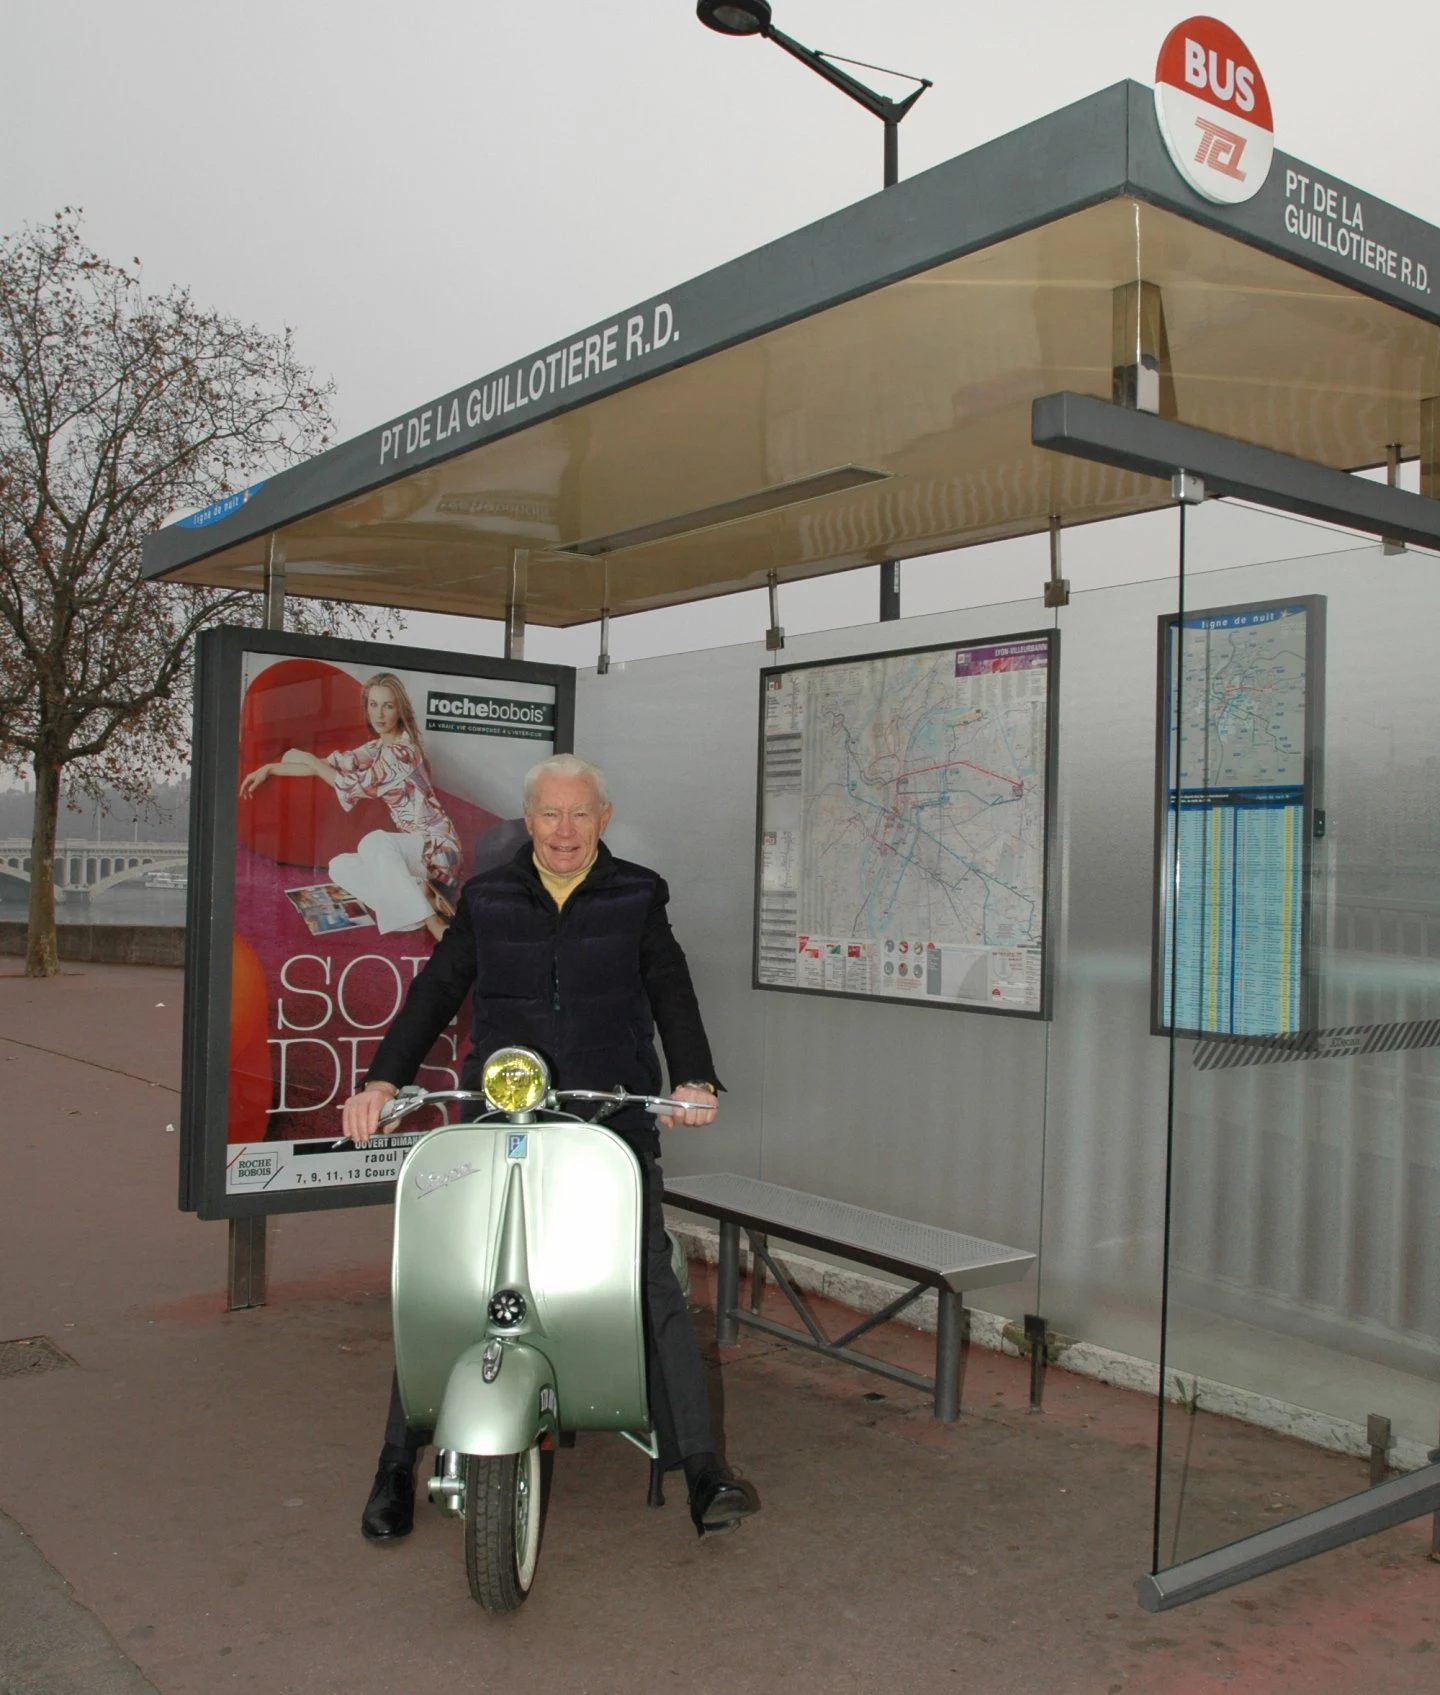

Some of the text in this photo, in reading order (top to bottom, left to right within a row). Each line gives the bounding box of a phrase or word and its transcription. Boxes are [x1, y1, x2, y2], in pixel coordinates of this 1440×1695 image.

[1184, 37, 1255, 112] BUS
[1286, 169, 1364, 231] PT DE LA
[1285, 203, 1432, 294] GUILLOTIERE R.D.
[380, 303, 680, 465] PT DE LA GUILLOTIERE R.D.
[1201, 612, 1274, 629] ligne de nuit
[429, 698, 544, 723] rochebobois
[238, 1158, 272, 1169] ROCHE
[366, 1150, 397, 1163] raoul
[238, 1167, 272, 1178] BOBOIS
[296, 1168, 396, 1184] 7, 9, 11, 13 Cours
